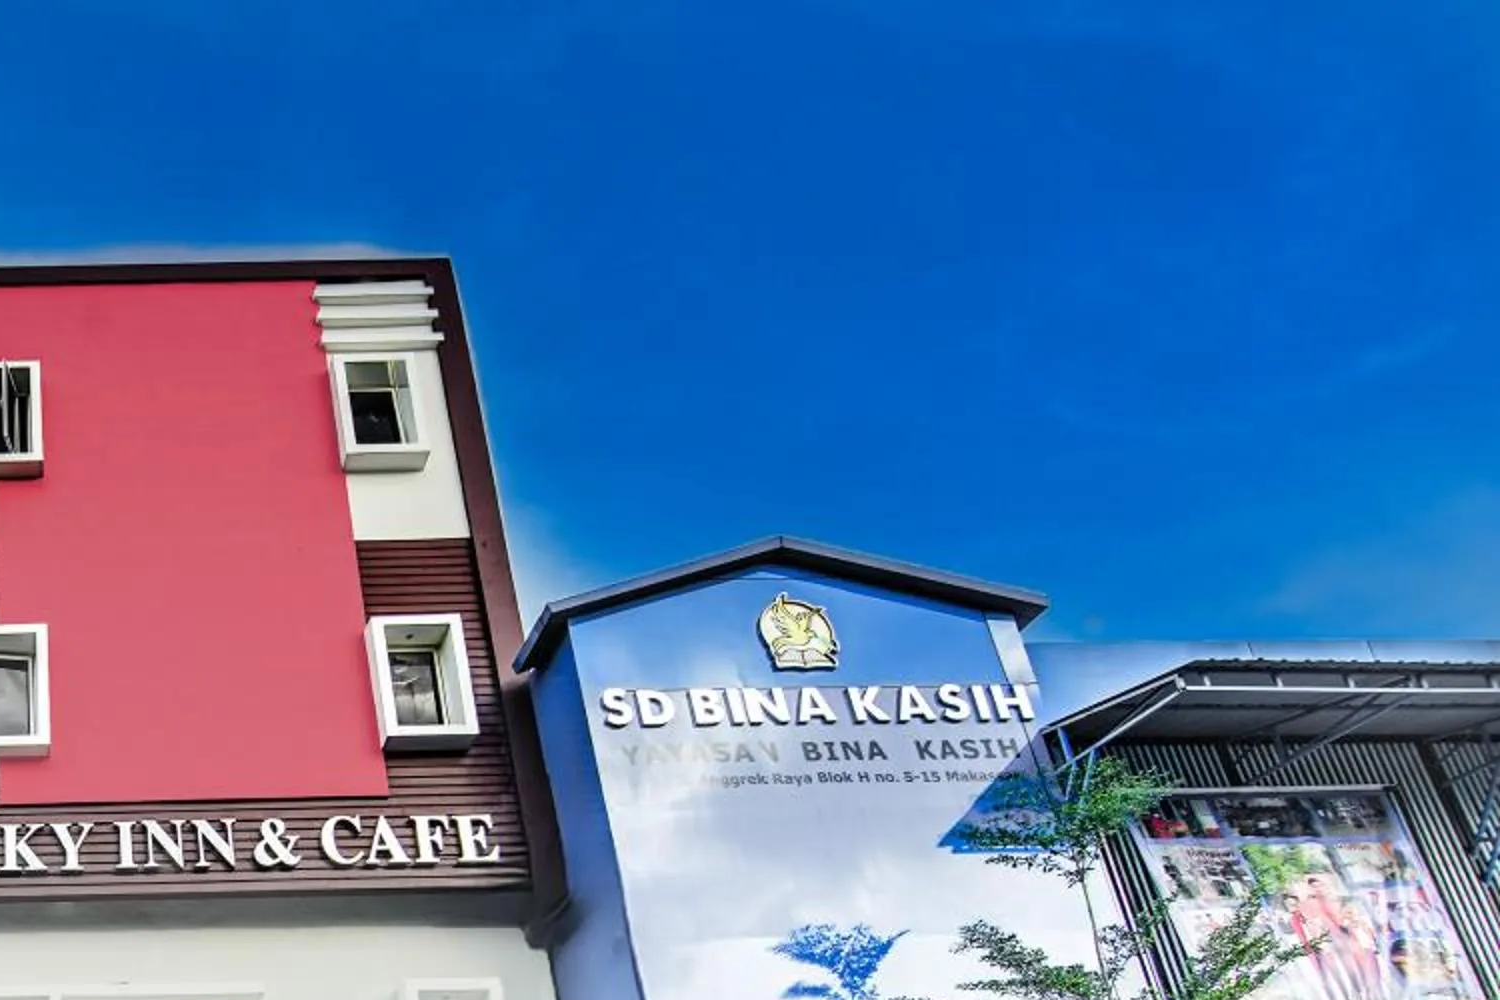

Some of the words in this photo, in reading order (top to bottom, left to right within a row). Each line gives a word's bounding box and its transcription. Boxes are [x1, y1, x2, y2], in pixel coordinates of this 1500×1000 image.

[602, 687, 675, 728] SD
[687, 686, 837, 727] BINA
[845, 683, 1035, 725] KASIH
[802, 740, 889, 761] BINA
[914, 738, 1020, 760] KASIH
[772, 772, 813, 787] Raya
[817, 771, 853, 784] Blok
[857, 771, 871, 784] H
[875, 773, 900, 784] no.
[113, 817, 237, 869] INN
[252, 818, 302, 869] &
[319, 813, 500, 867] CAFE
